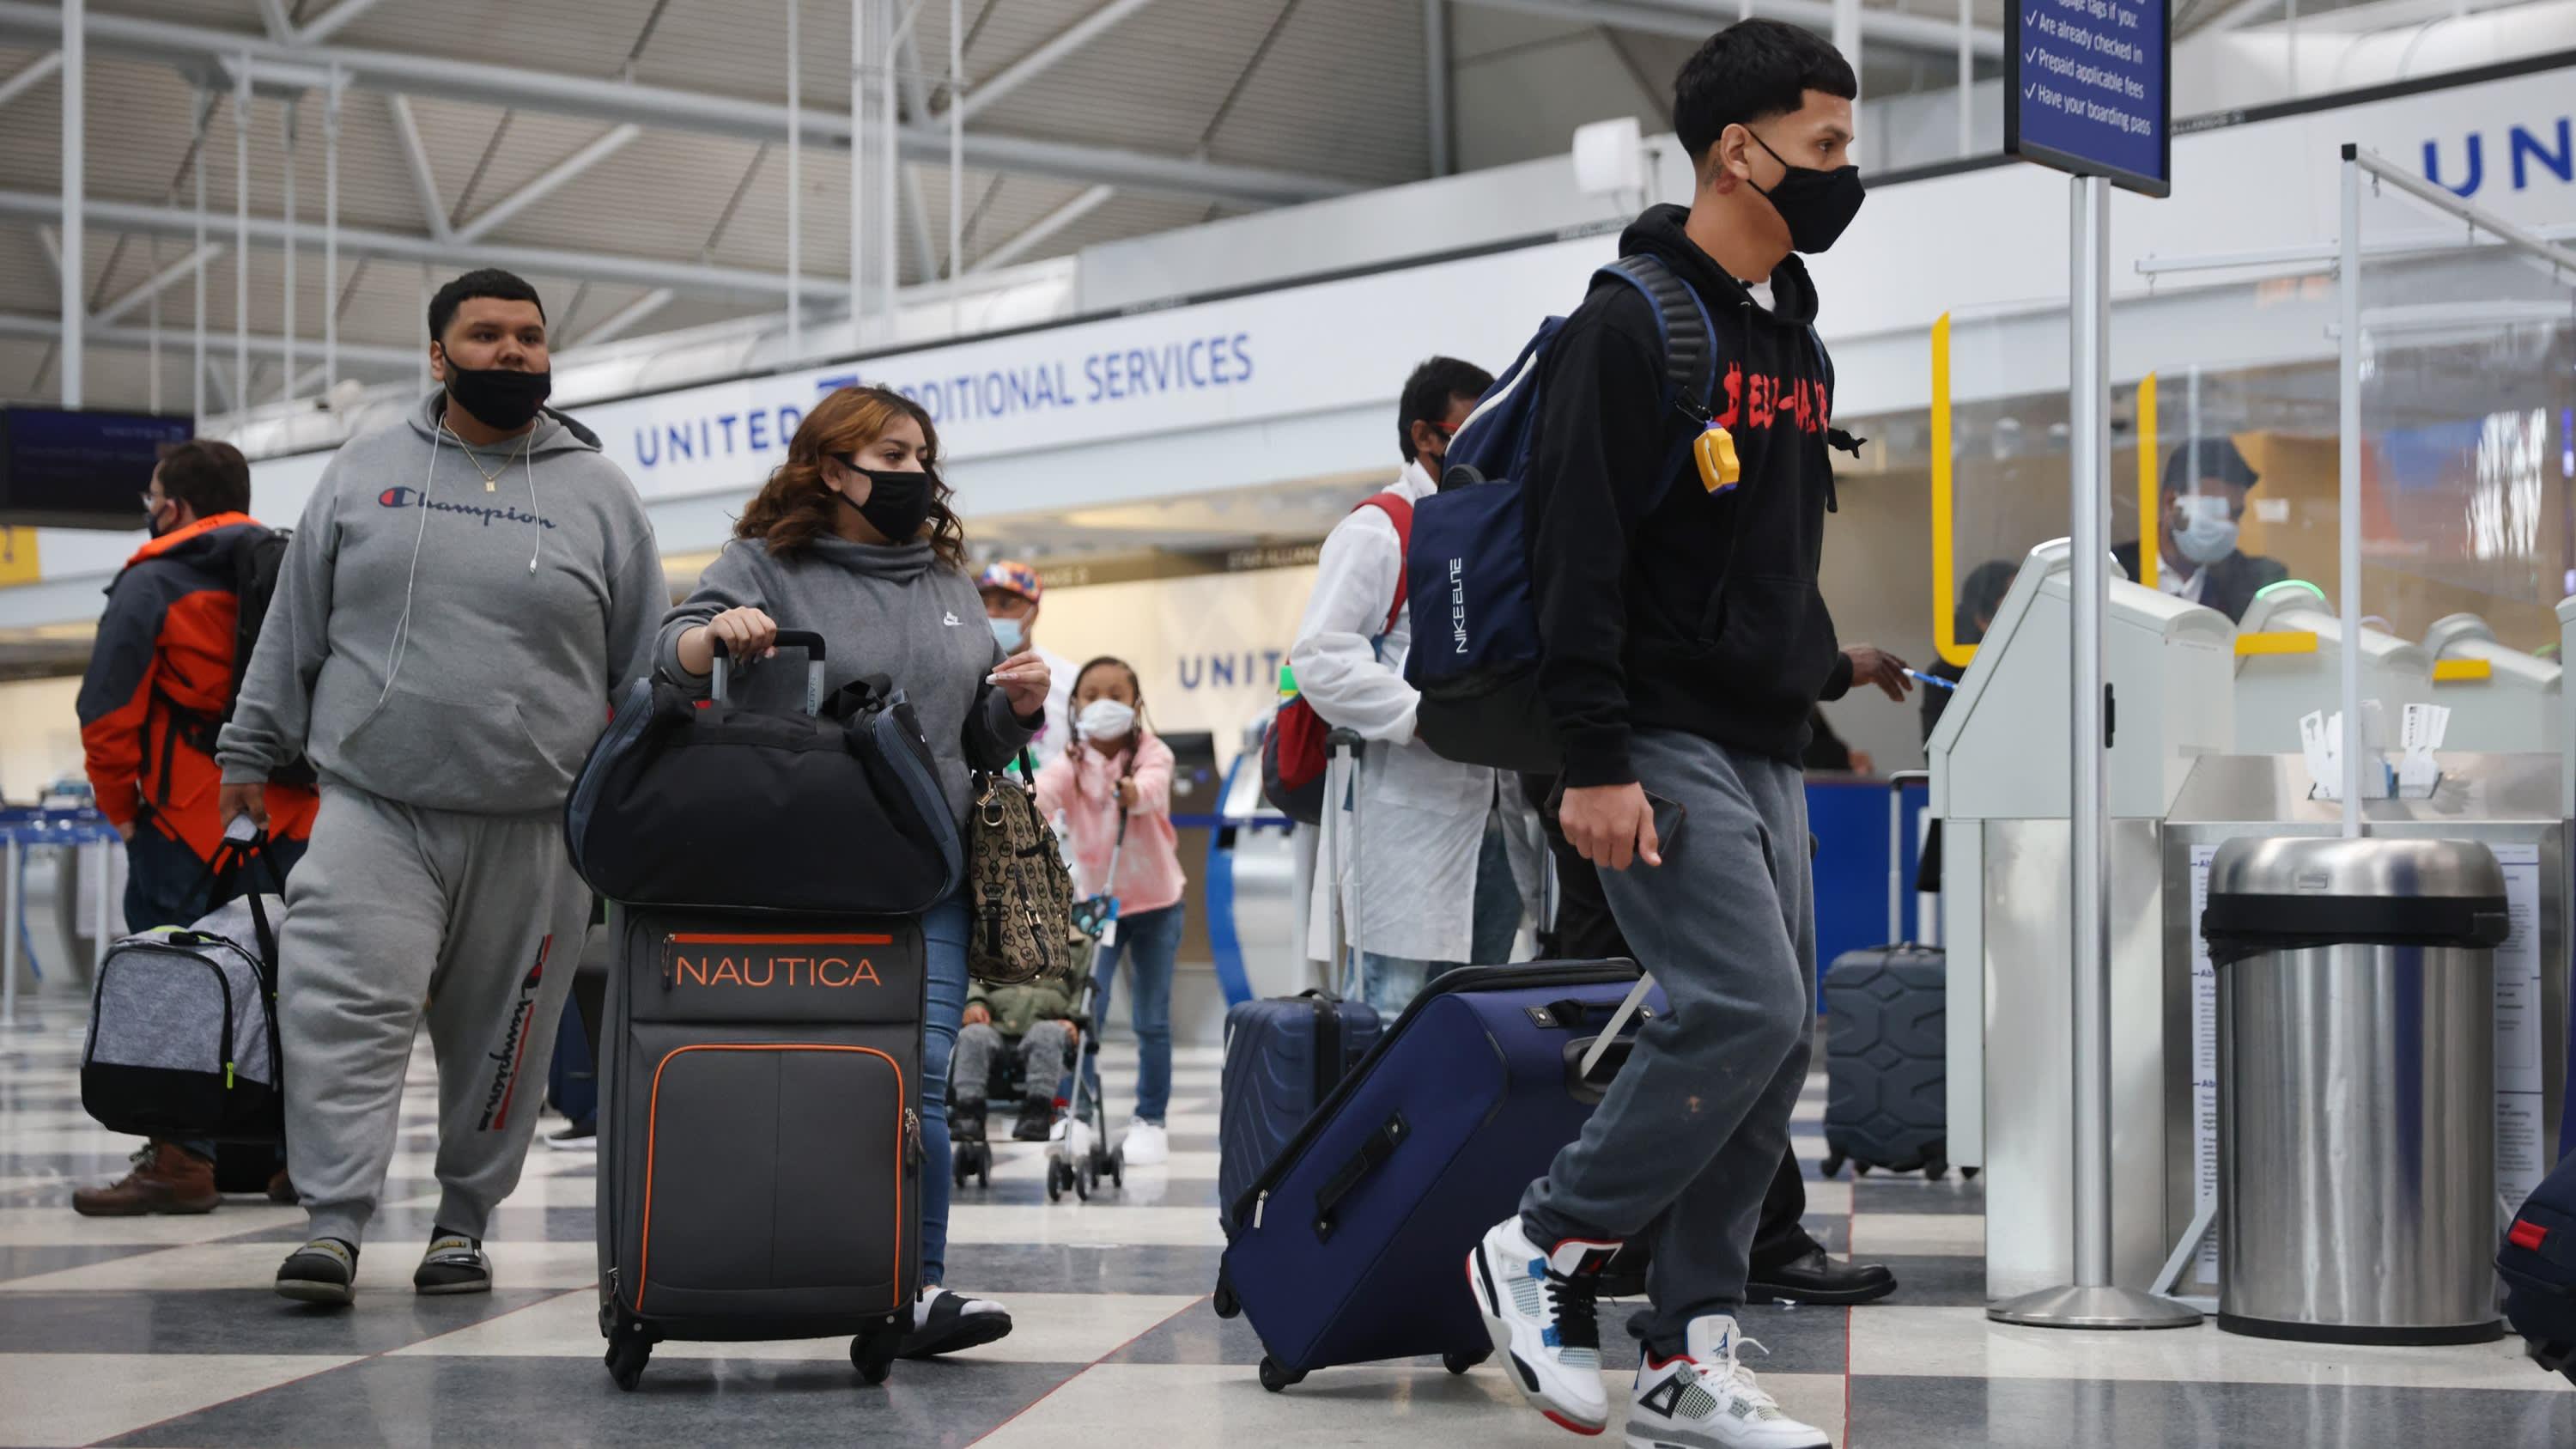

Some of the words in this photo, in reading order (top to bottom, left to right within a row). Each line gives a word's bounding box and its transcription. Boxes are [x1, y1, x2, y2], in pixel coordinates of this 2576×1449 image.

[2108, 2, 2117, 21] if
[2038, 13, 2056, 35] Are
[2057, 21, 2093, 51] already
[2093, 33, 2132, 61] checked
[2133, 43, 2143, 64] in
[2038, 47, 2075, 77] Prepaid
[2075, 64, 2123, 94] applicable
[2124, 76, 2144, 100] fees
[2038, 83, 2062, 109] Have
[2063, 95, 2086, 116] your
[2087, 99, 2129, 132] boarding
[2130, 116, 2152, 136] pass
[634, 405, 802, 468] UNITED
[1084, 332, 1254, 403] SERVICES
[378, 485, 556, 529] Champion
[677, 955, 881, 987] NAUTICA
